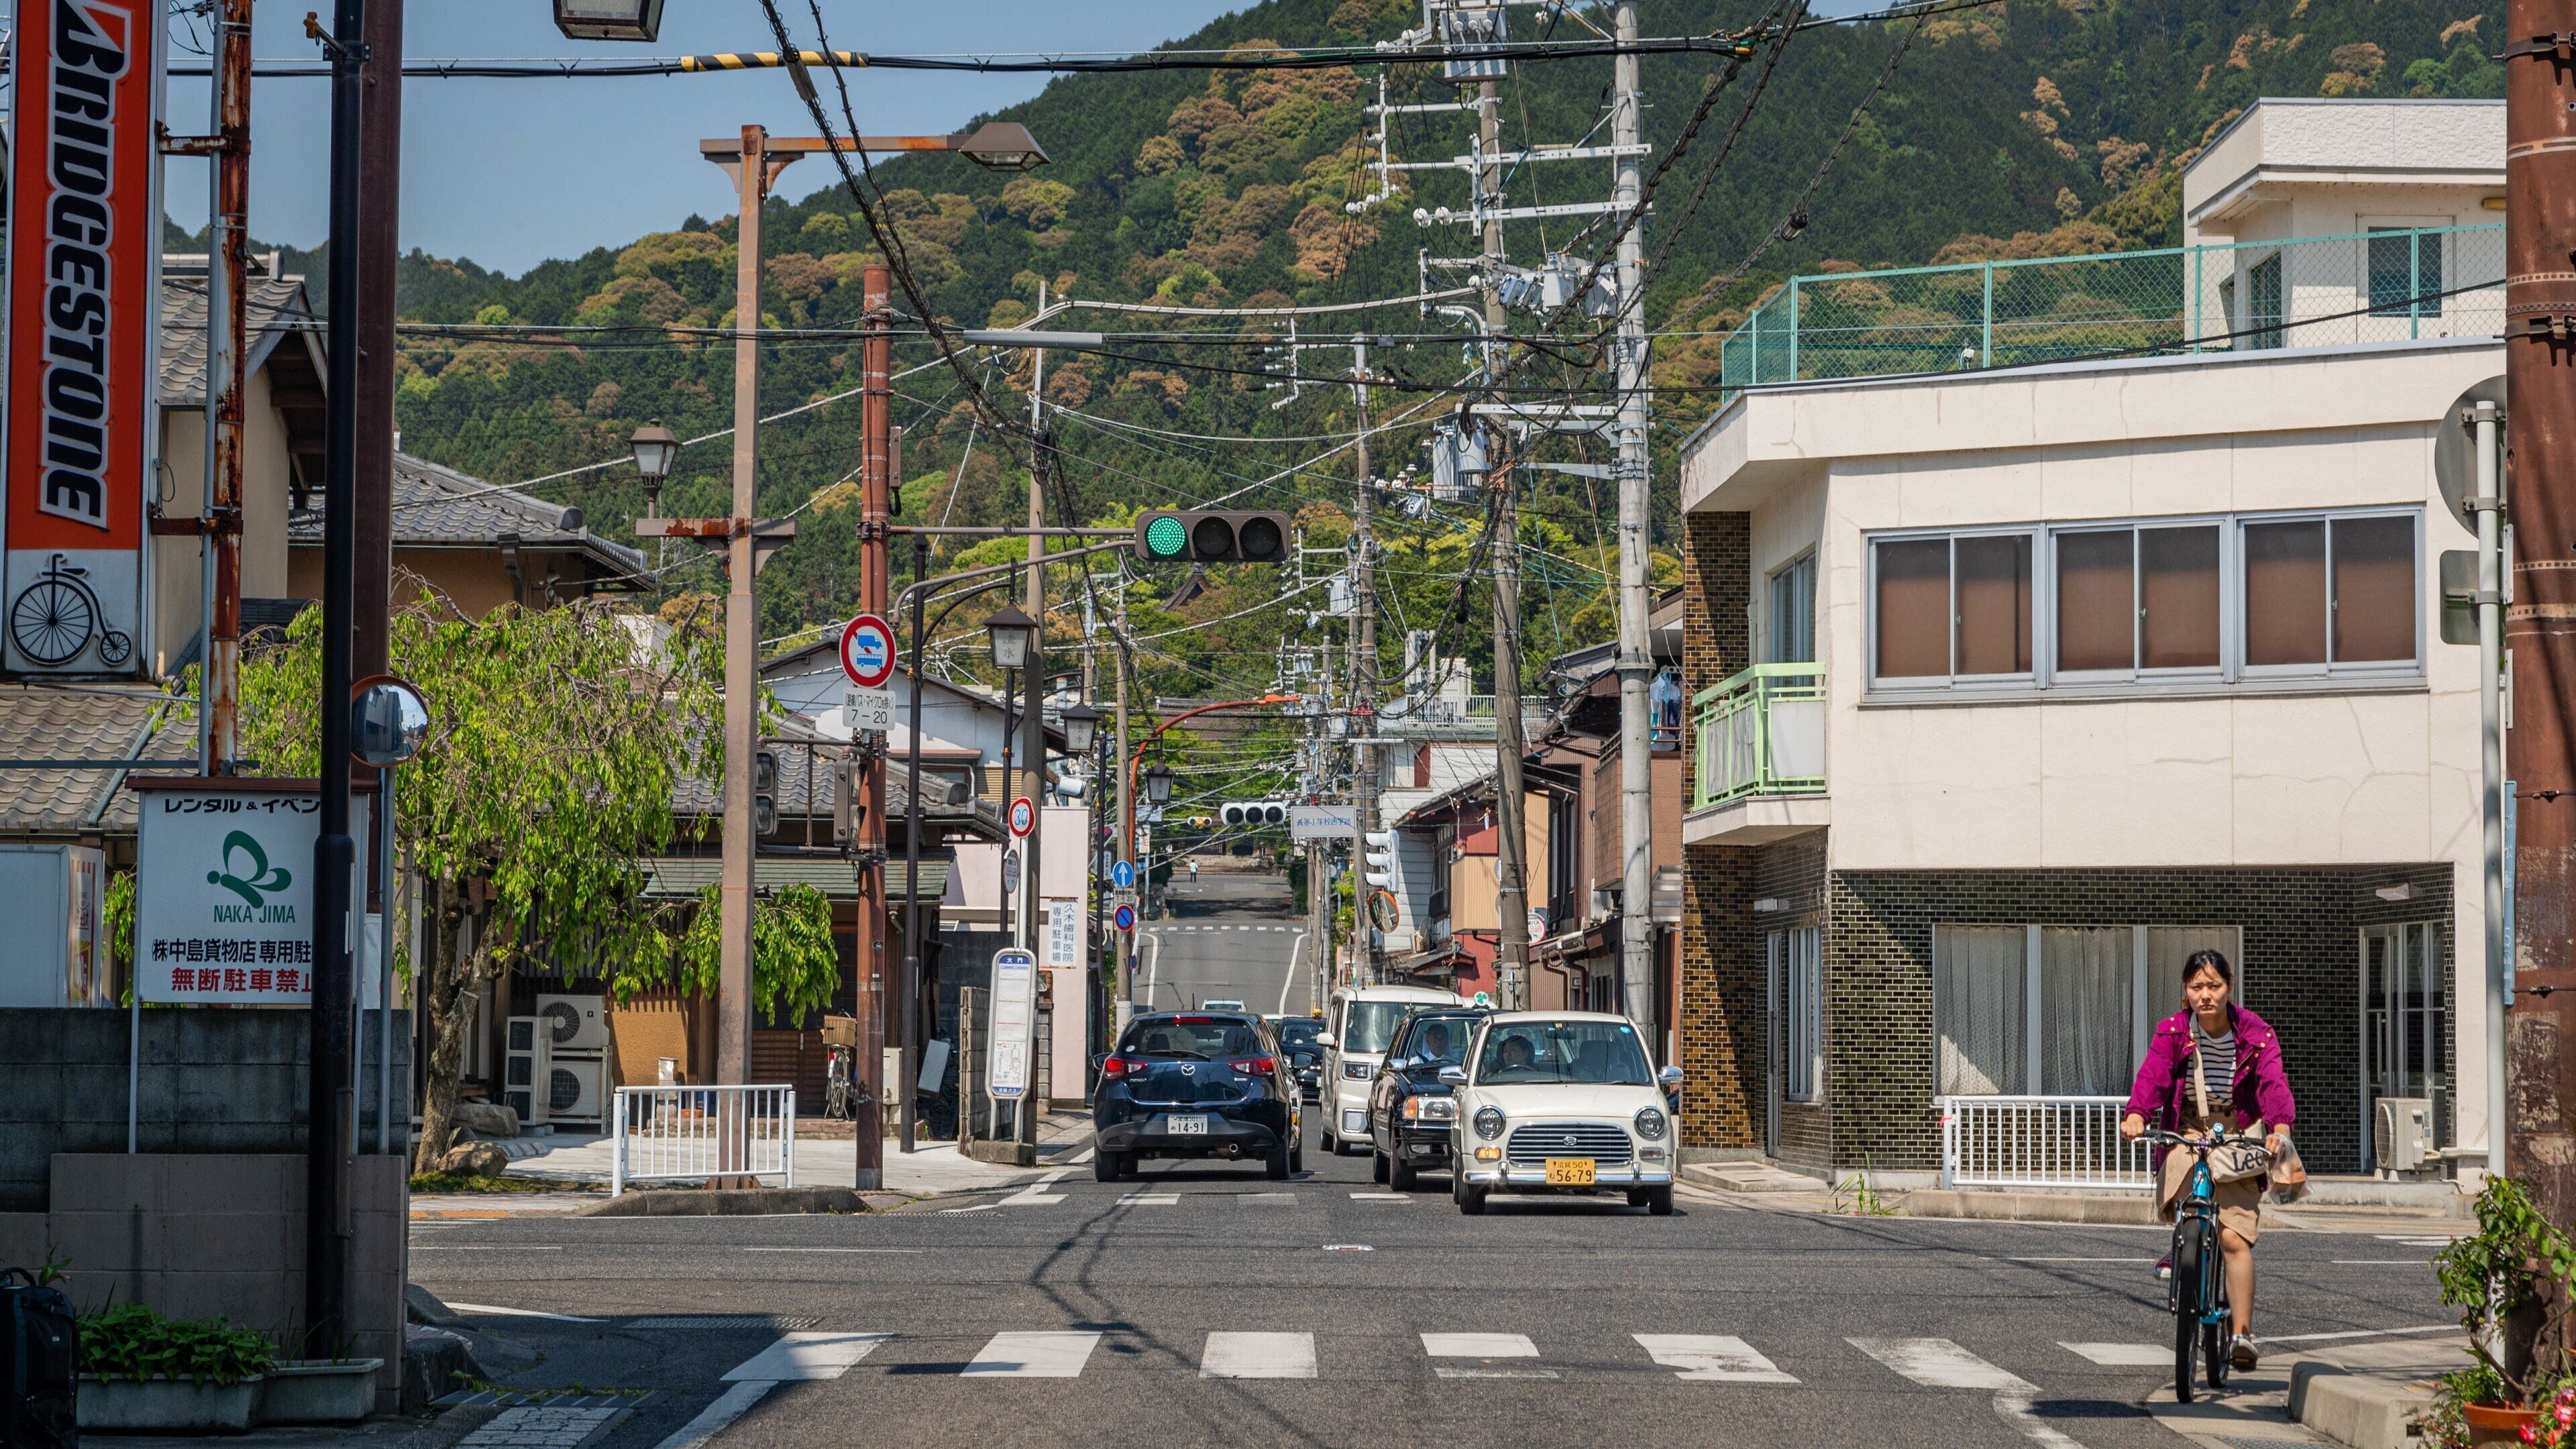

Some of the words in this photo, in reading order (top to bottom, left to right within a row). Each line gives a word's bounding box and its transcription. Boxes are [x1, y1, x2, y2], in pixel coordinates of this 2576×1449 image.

[44, 0, 127, 521] BRIDGESTONE
[1014, 809, 1028, 825] 30
[1178, 1122, 1203, 1132] 14-91
[2231, 1150, 2263, 1172] Lee
[1556, 1169, 1592, 1182] 56-79
